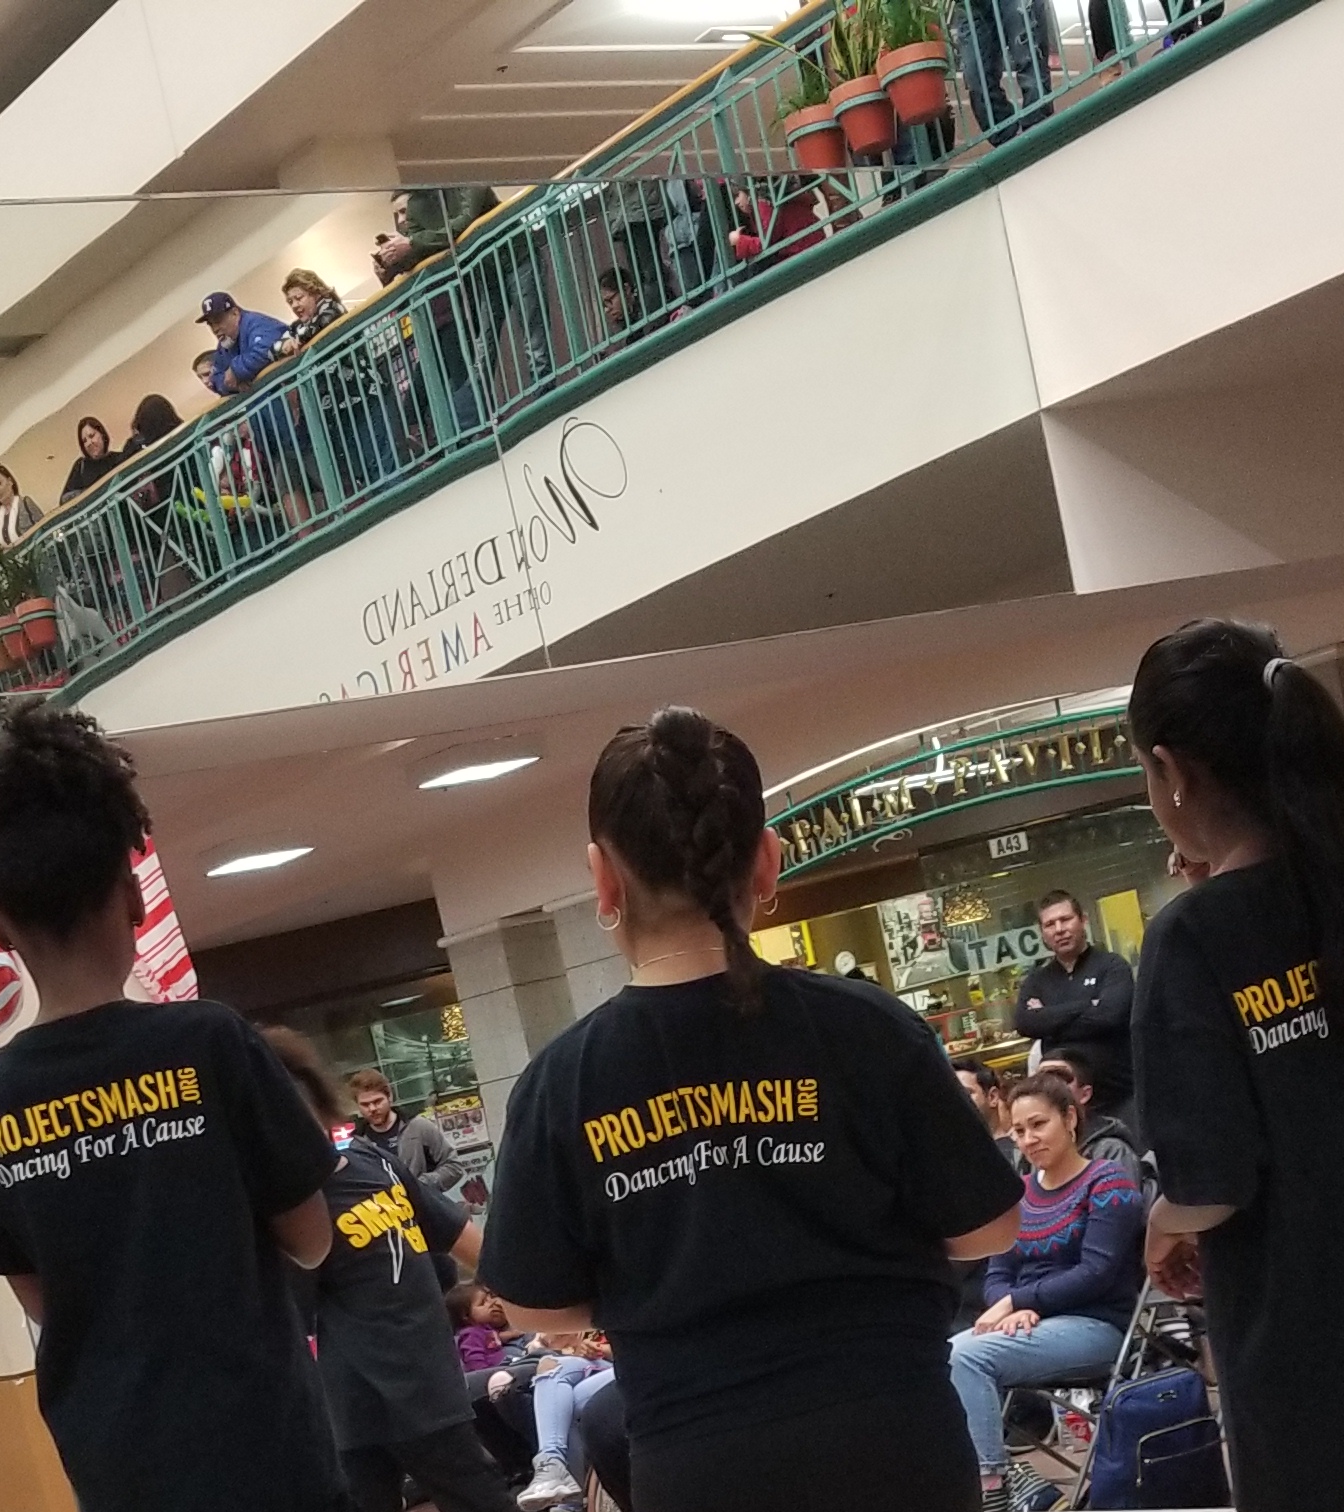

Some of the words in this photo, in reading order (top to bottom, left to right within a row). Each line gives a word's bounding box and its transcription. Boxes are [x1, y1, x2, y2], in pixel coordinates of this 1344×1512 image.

[203, 298, 213, 312] T
[996, 835, 1022, 856] A43
[968, 928, 1040, 970] TAC
[1248, 1005, 1329, 1055] Dancing
[74, 1134, 116, 1164] For
[120, 1121, 140, 1156] A
[142, 1115, 206, 1149] Cause
[694, 1139, 730, 1172] For
[732, 1135, 750, 1170] A
[757, 1136, 825, 1167] Cause
[336, 1182, 415, 1249] SMAS
